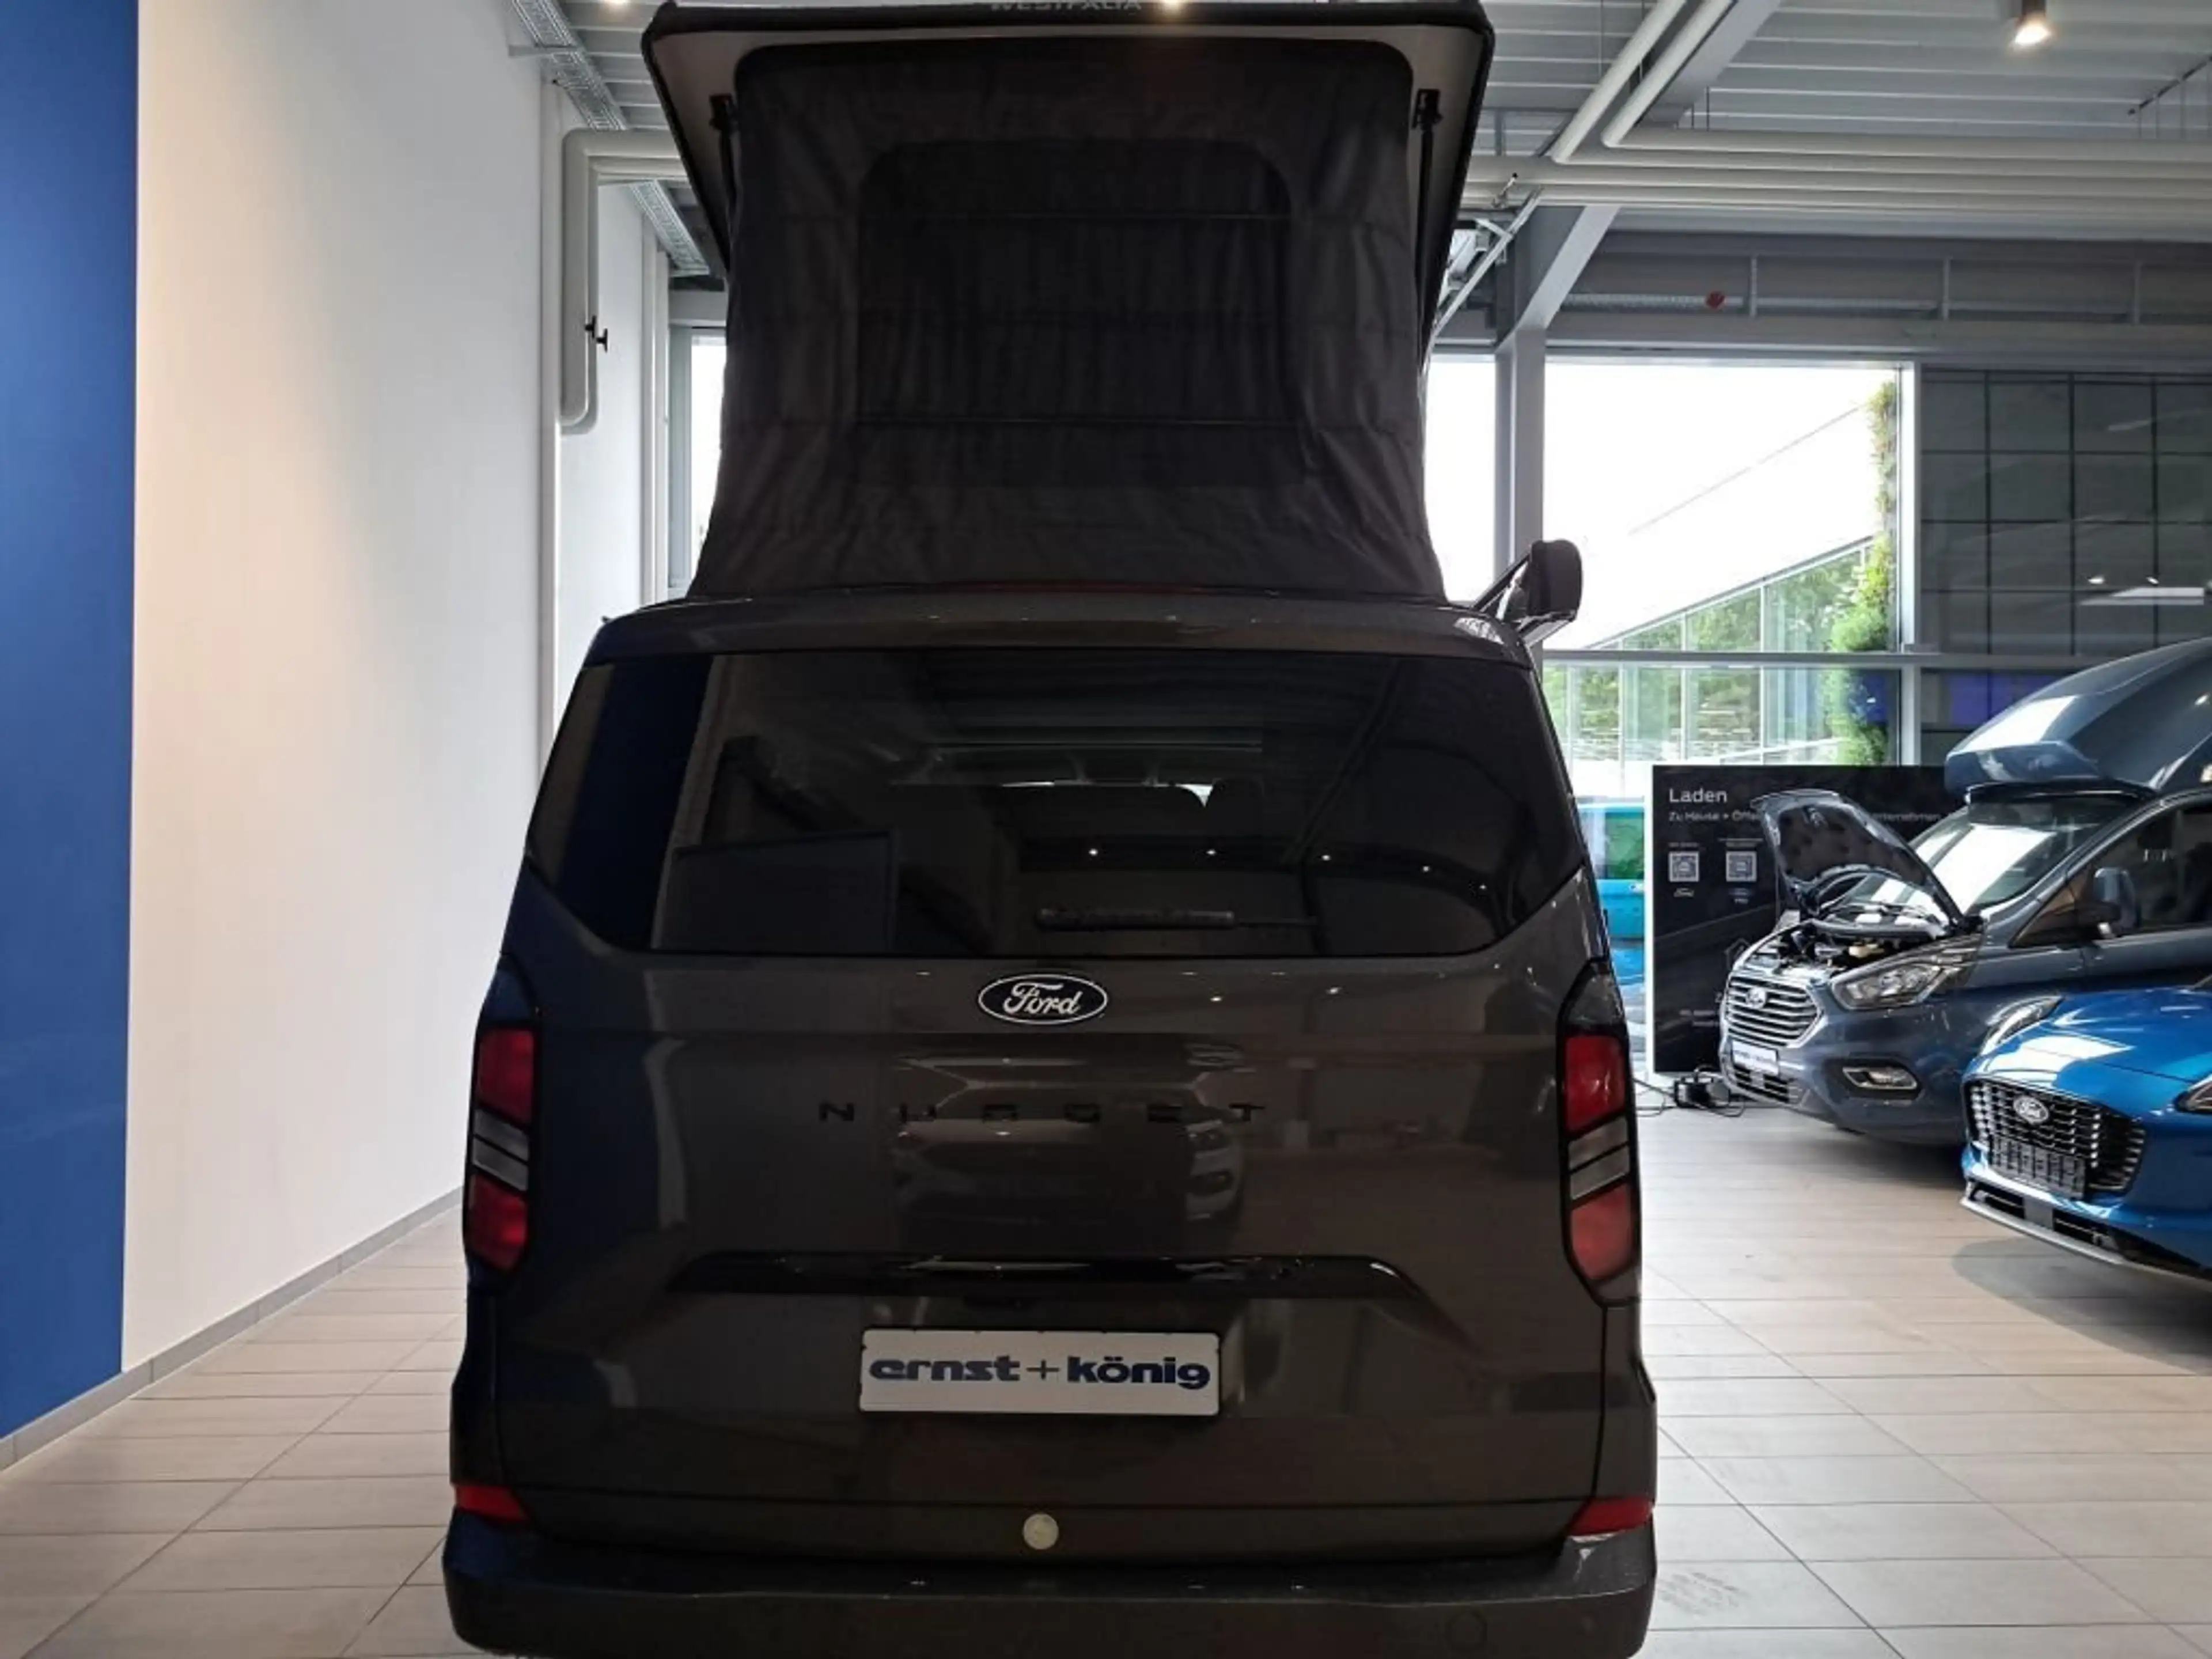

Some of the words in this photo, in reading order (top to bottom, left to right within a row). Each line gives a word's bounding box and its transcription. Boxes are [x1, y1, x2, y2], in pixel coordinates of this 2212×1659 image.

[1669, 787, 1727, 802] Laden
[1003, 982, 1083, 1014] Ford
[869, 1355, 1020, 1381] ernst
[1067, 1355, 1211, 1389] könig
